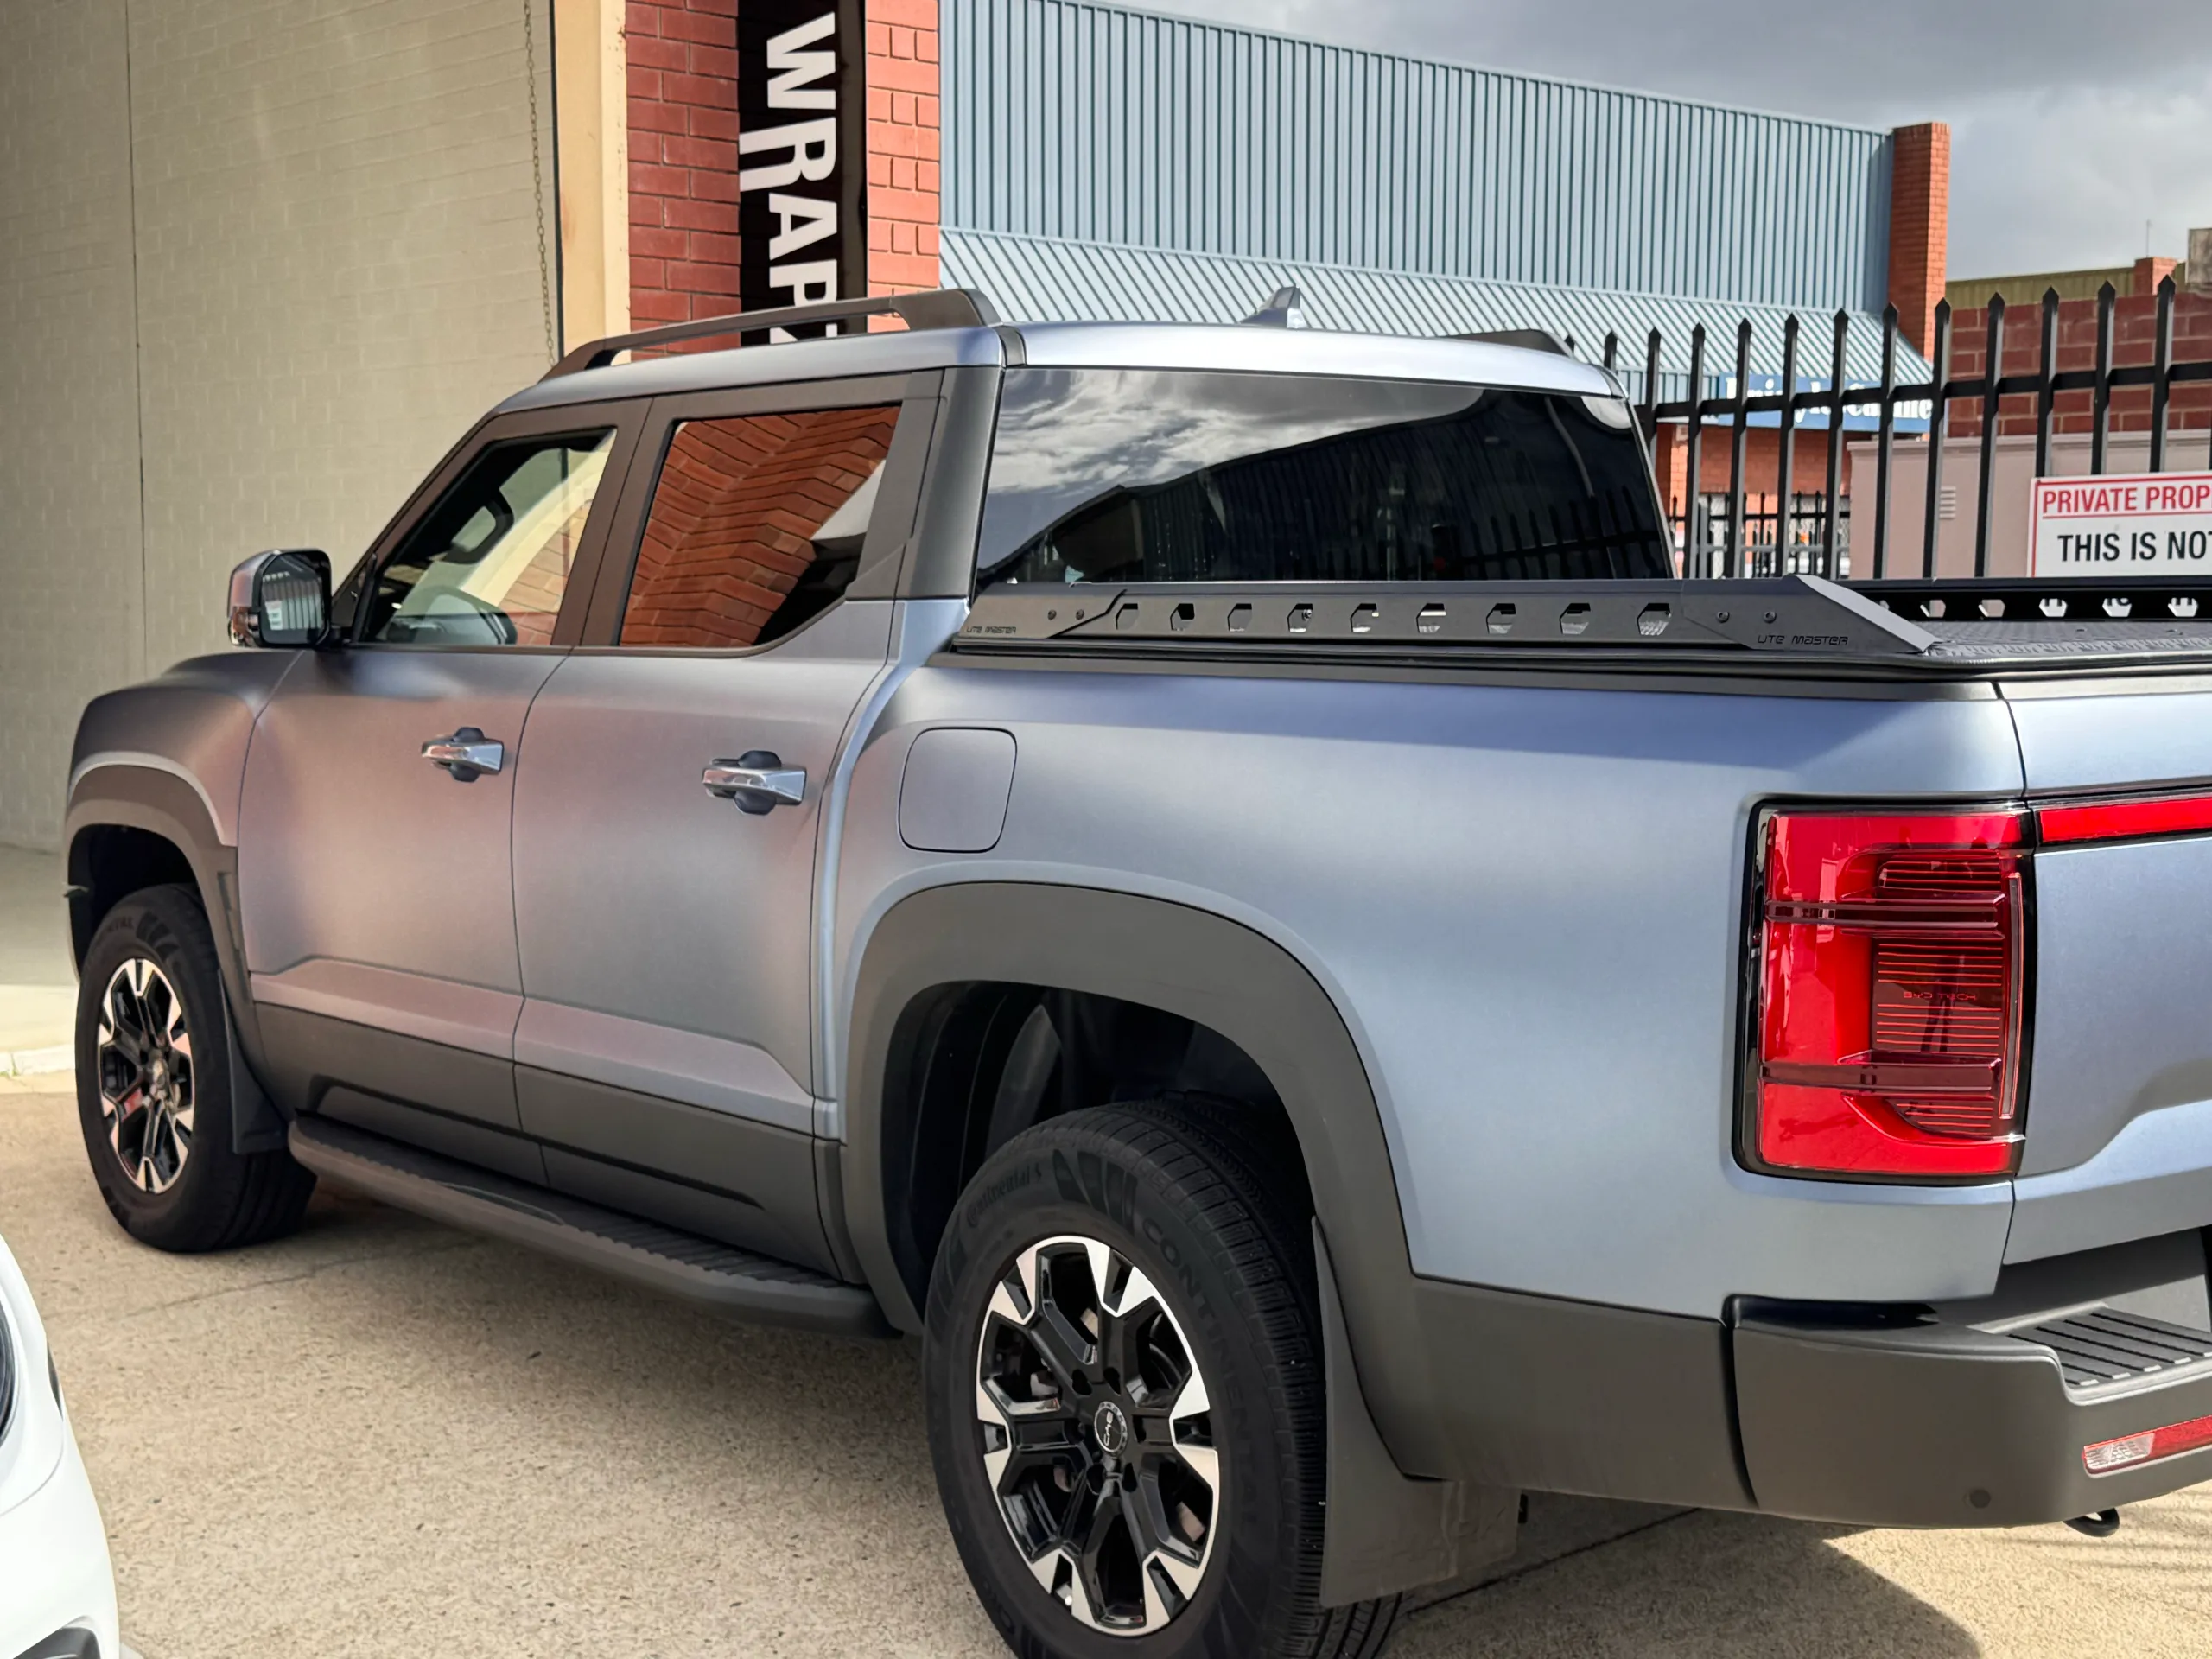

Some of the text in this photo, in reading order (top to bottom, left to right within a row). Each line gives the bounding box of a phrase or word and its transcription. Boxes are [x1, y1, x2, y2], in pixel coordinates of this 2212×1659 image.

[739, 11, 838, 344] WRAP
[2043, 485, 2212, 513] PRIVATE PROP
[2057, 533, 2120, 562] THIS
[2131, 532, 2157, 560] IS
[1757, 635, 1785, 645] UTE
